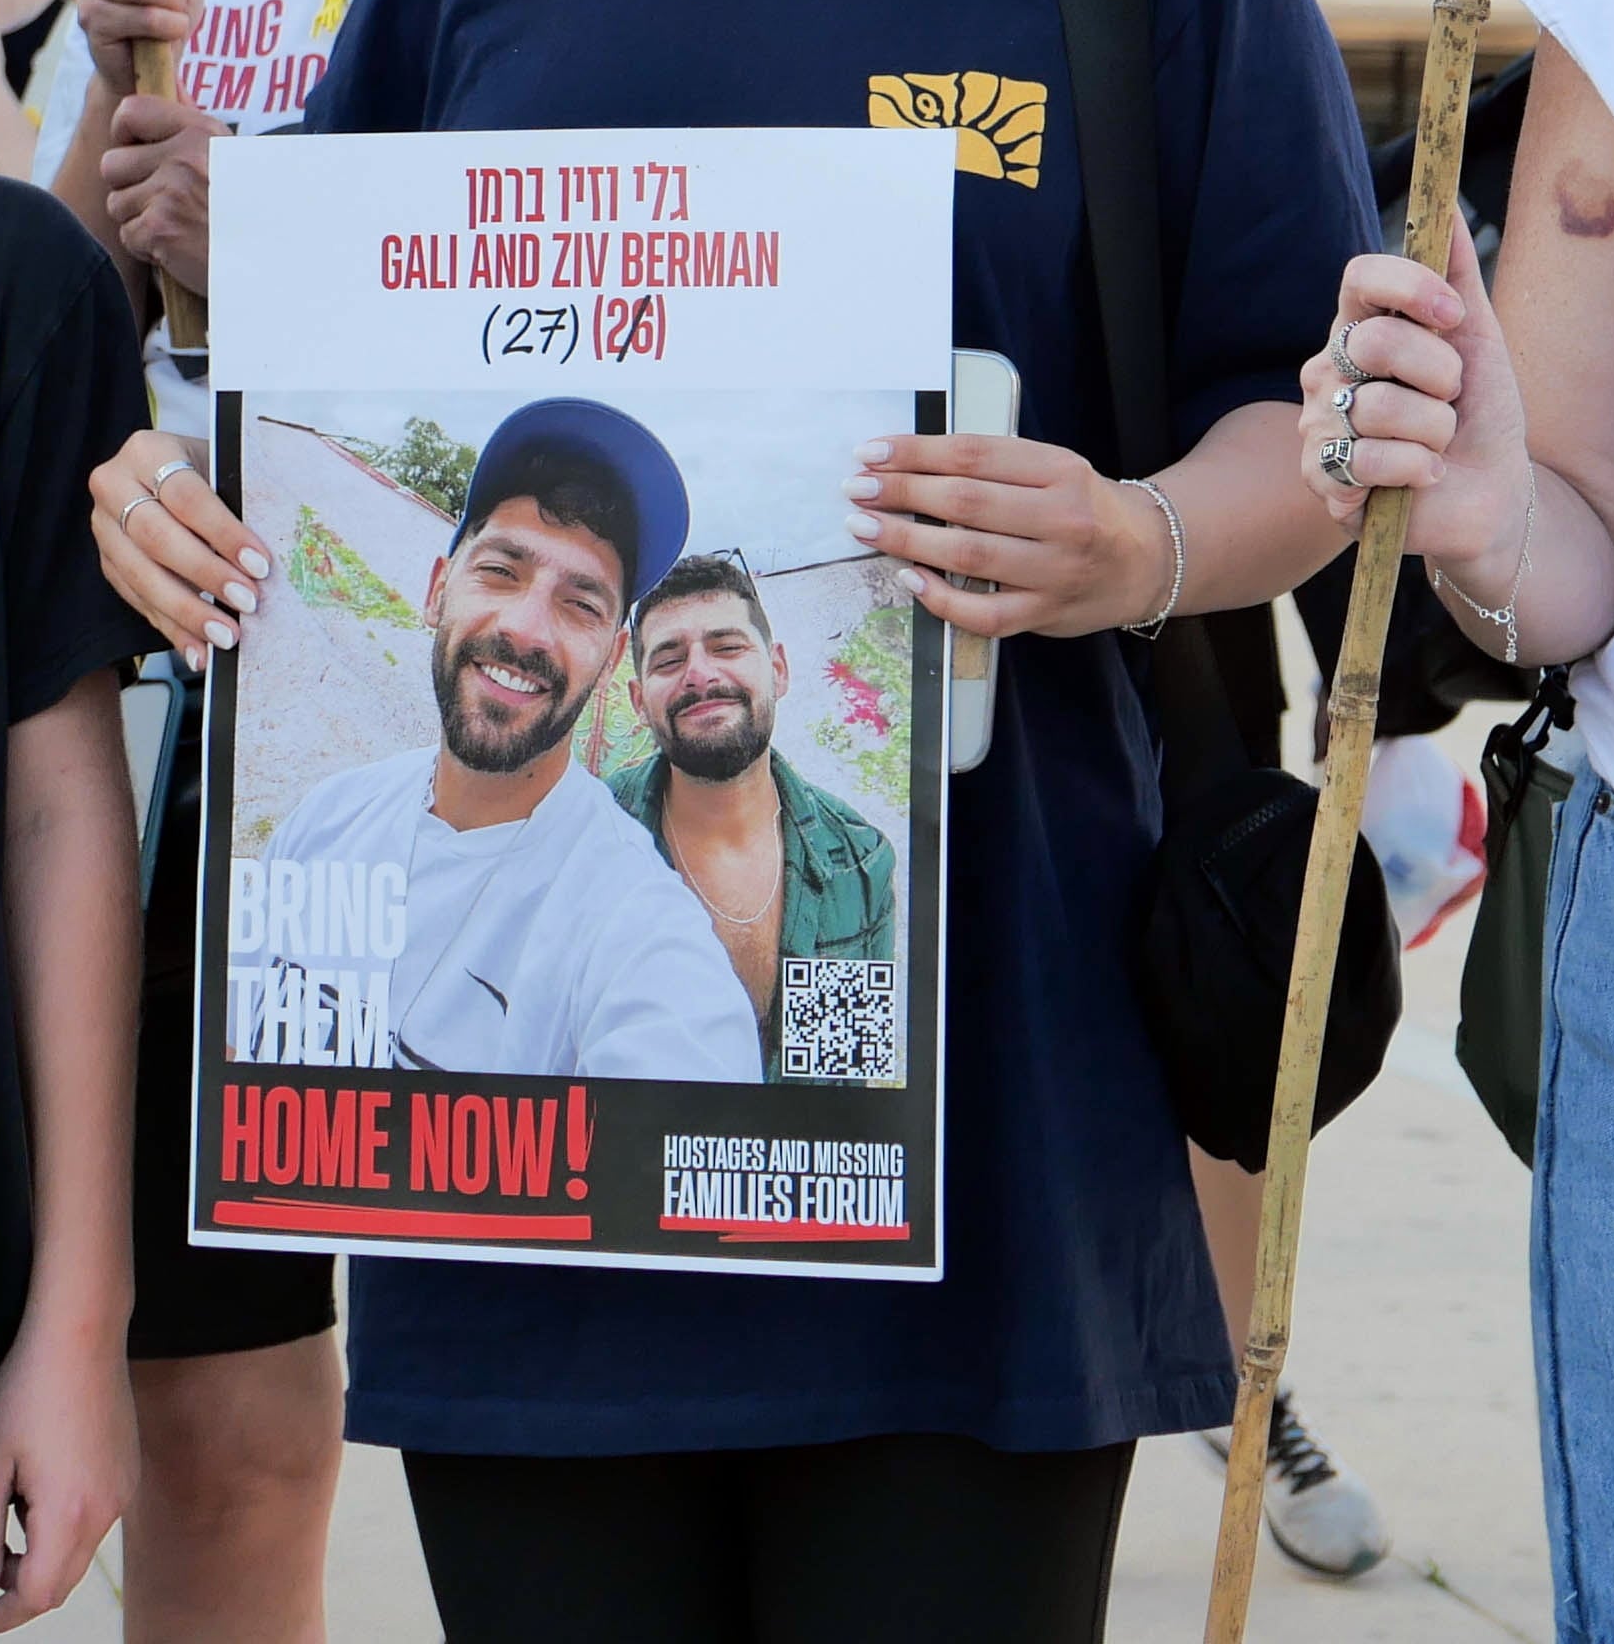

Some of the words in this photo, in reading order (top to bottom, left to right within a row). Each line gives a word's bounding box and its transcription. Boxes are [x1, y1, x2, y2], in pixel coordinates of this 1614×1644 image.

[466, 166, 546, 228] ברמן
[557, 166, 619, 221] וזיו
[635, 160, 691, 220] גלי
[381, 234, 458, 290] GALI
[469, 232, 540, 289] AND
[550, 231, 607, 288] ZIV
[622, 231, 780, 288] BERMAN
[482, 302, 579, 364] (27)
[594, 295, 666, 362] (26)
[228, 857, 407, 960] BRING
[227, 964, 392, 1070] THEM
[221, 1085, 392, 1188] HOME
[410, 1085, 597, 1200] NOW!
[663, 1134, 765, 1171] HOSTAGES
[768, 1139, 809, 1172] AND
[812, 1141, 905, 1178] MISSING
[663, 1169, 793, 1223] FAMILIES
[799, 1175, 905, 1227] FORUM
